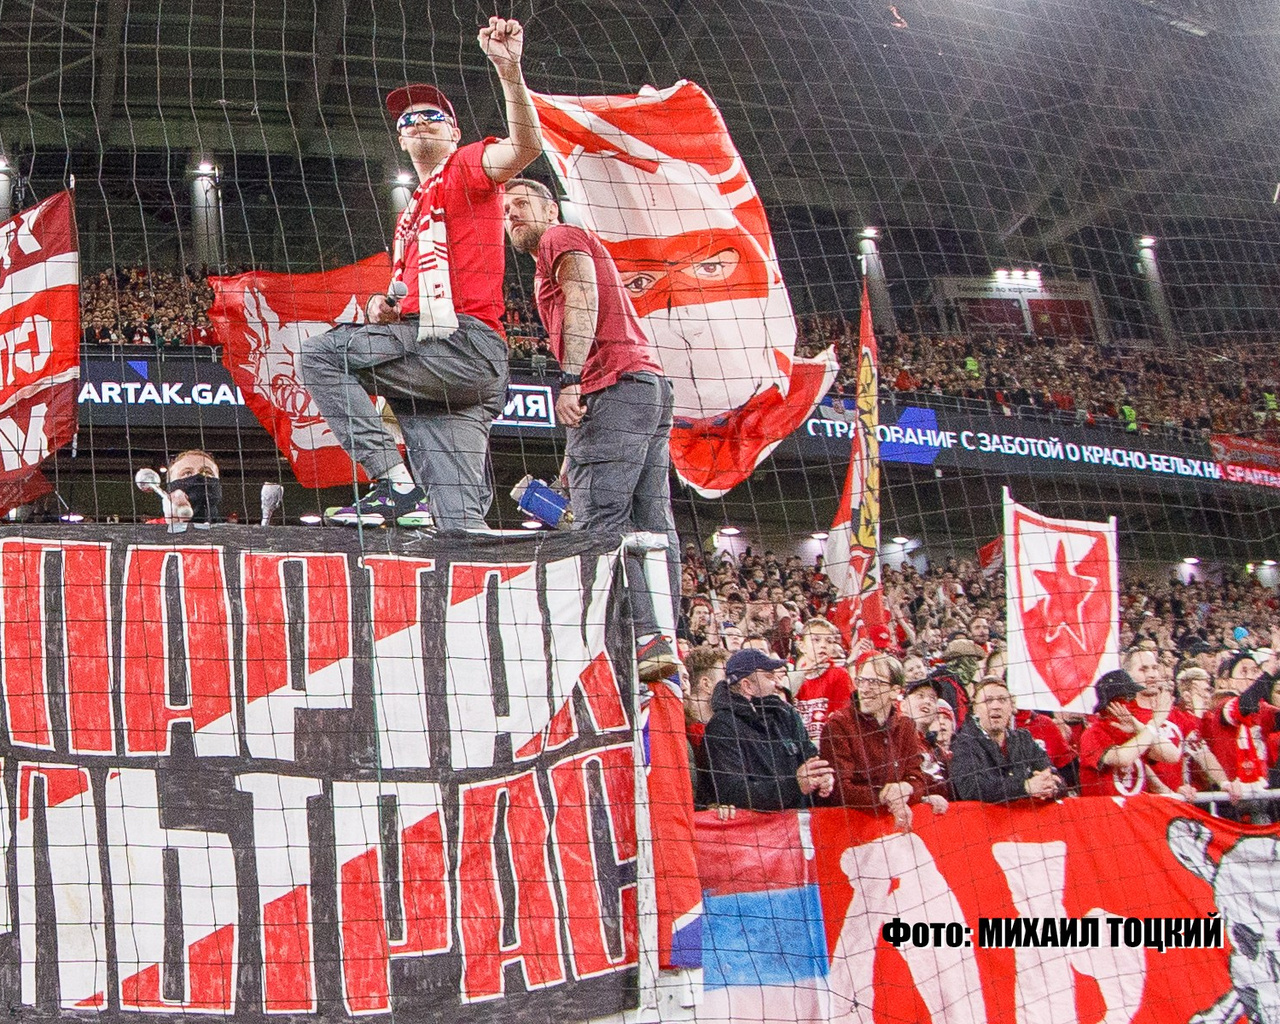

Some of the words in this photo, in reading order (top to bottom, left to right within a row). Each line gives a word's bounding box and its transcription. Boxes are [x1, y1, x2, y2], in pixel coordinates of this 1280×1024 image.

[78, 381, 246, 405] ARTAK.GA
[979, 432, 1064, 460] ЗАБОТОЙ
[1066, 442, 1081, 462] О
[1082, 445, 1203, 478] КРАСНО-БЕЛЫХ
